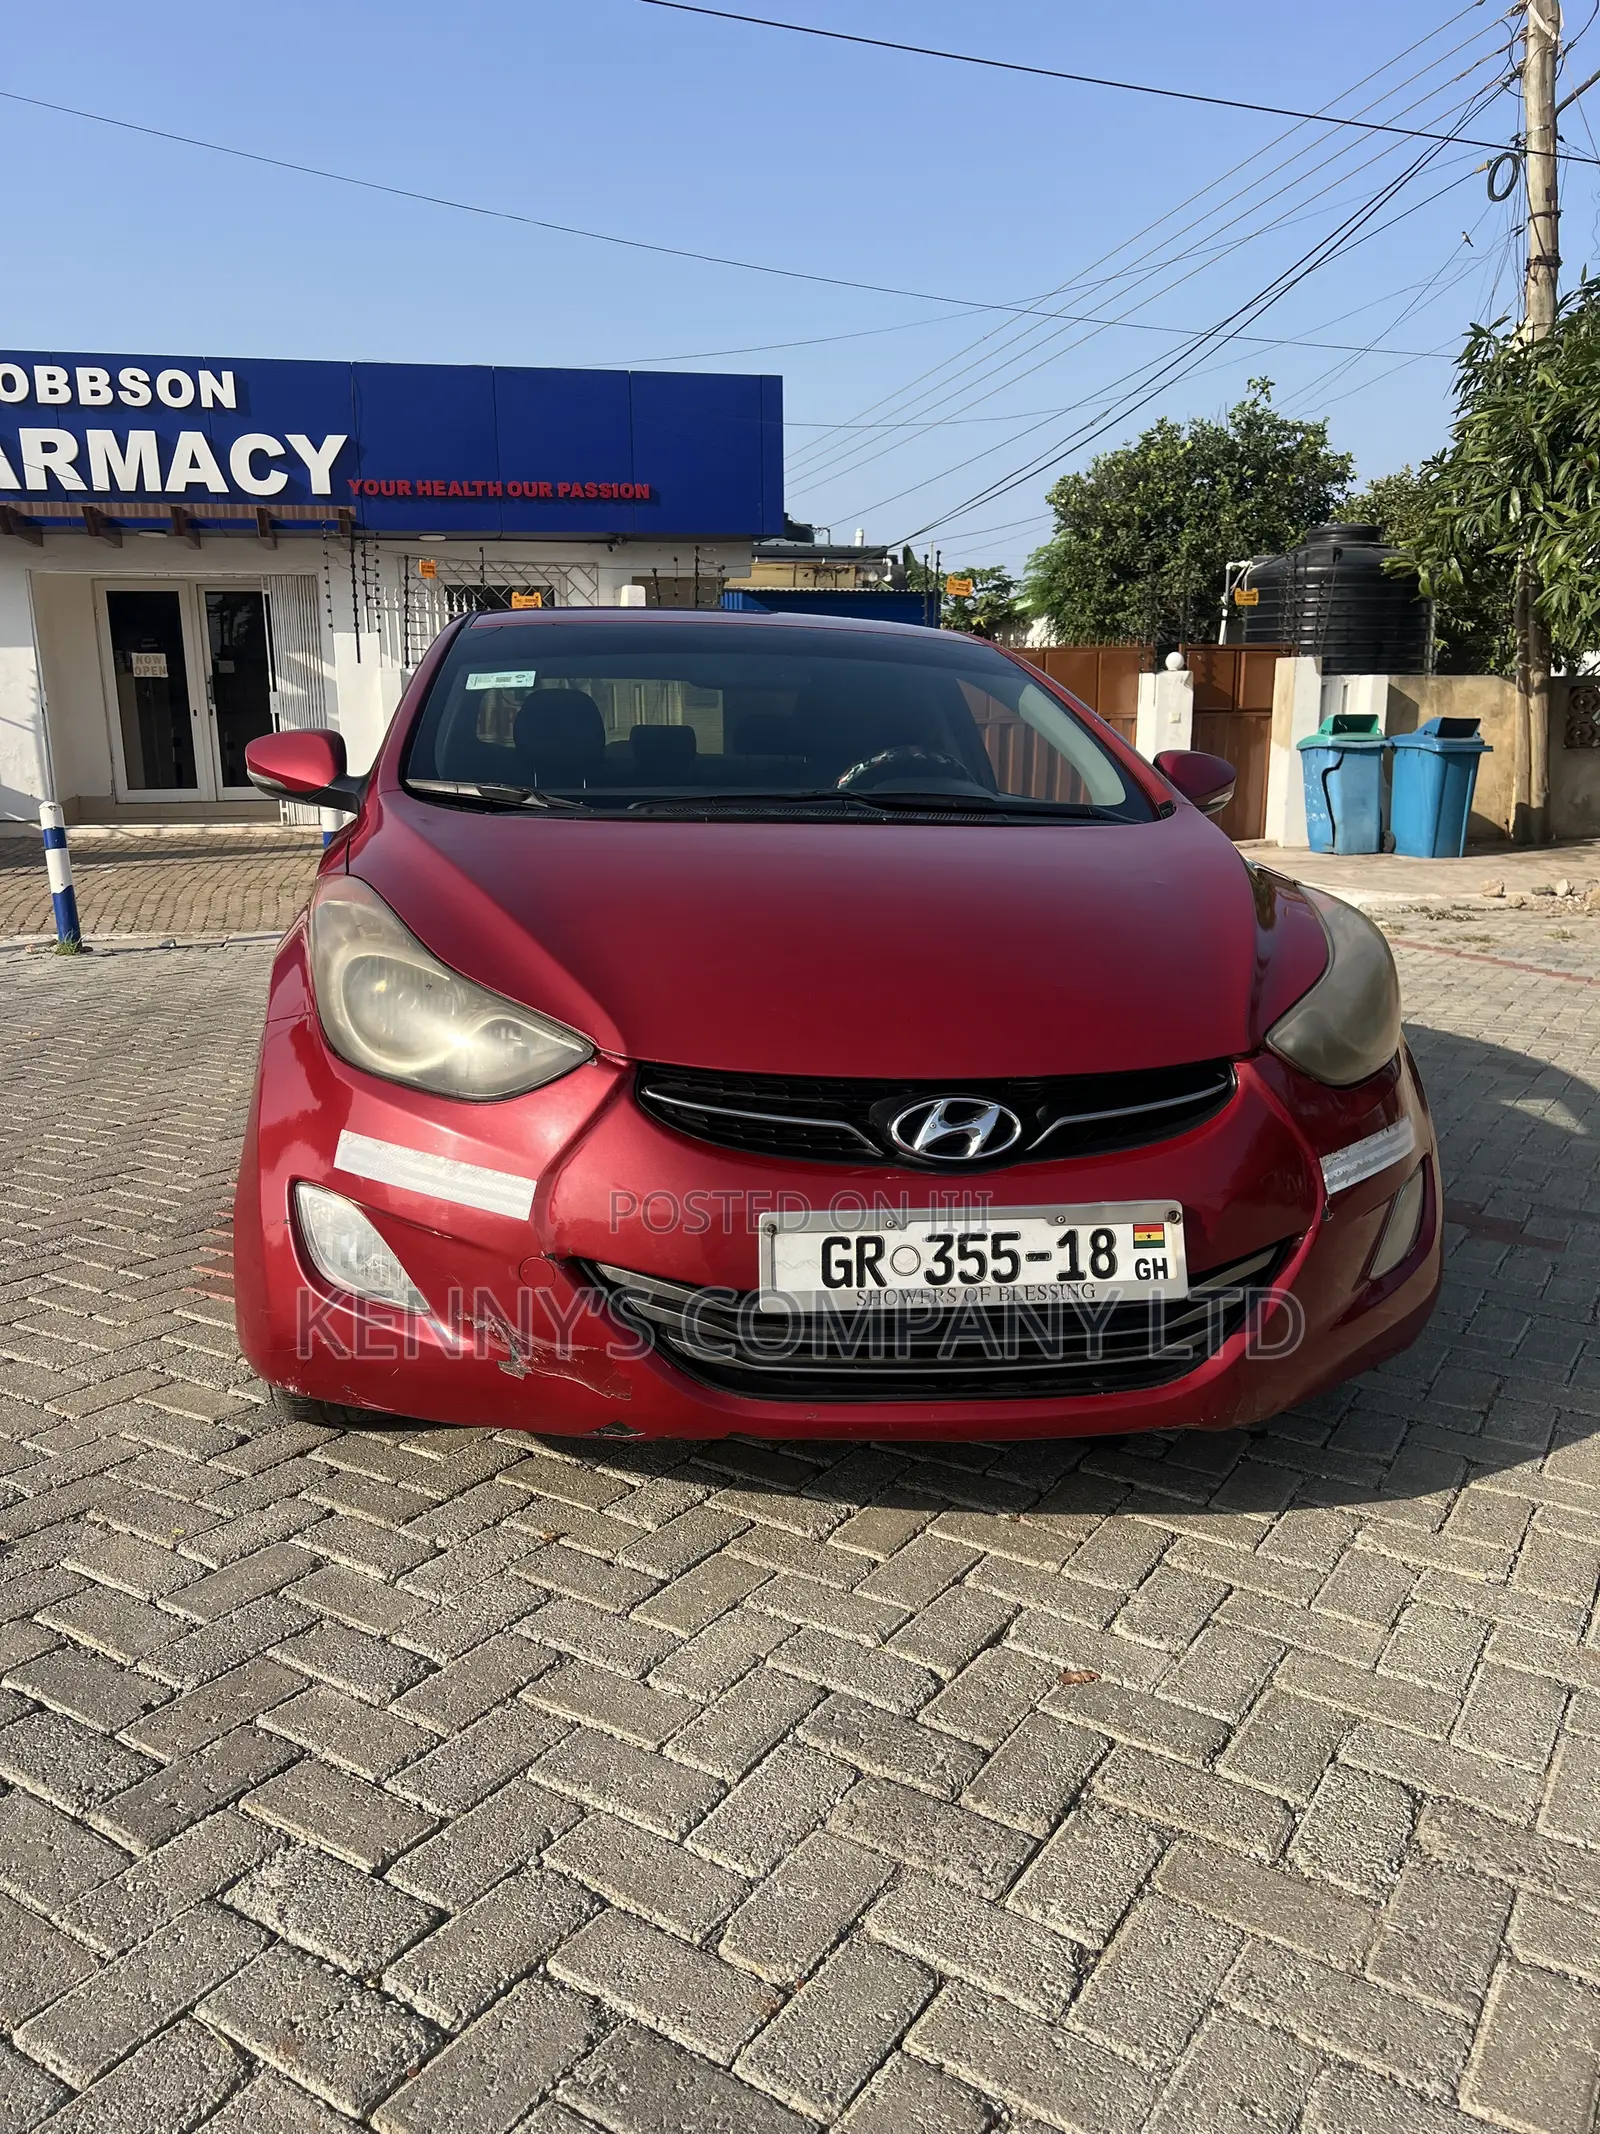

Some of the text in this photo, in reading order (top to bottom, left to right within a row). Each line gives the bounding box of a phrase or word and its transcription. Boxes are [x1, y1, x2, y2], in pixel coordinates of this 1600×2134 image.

[347, 479, 650, 499] YOUR HEALTH OUR PASSION
[134, 665, 167, 676] OPEN
[136, 655, 162, 665] NOW
[821, 1227, 1118, 1289] GR 355-18
[1134, 1257, 1169, 1281] GH
[856, 1282, 1096, 1307] SHOWERS OF BLESSING
